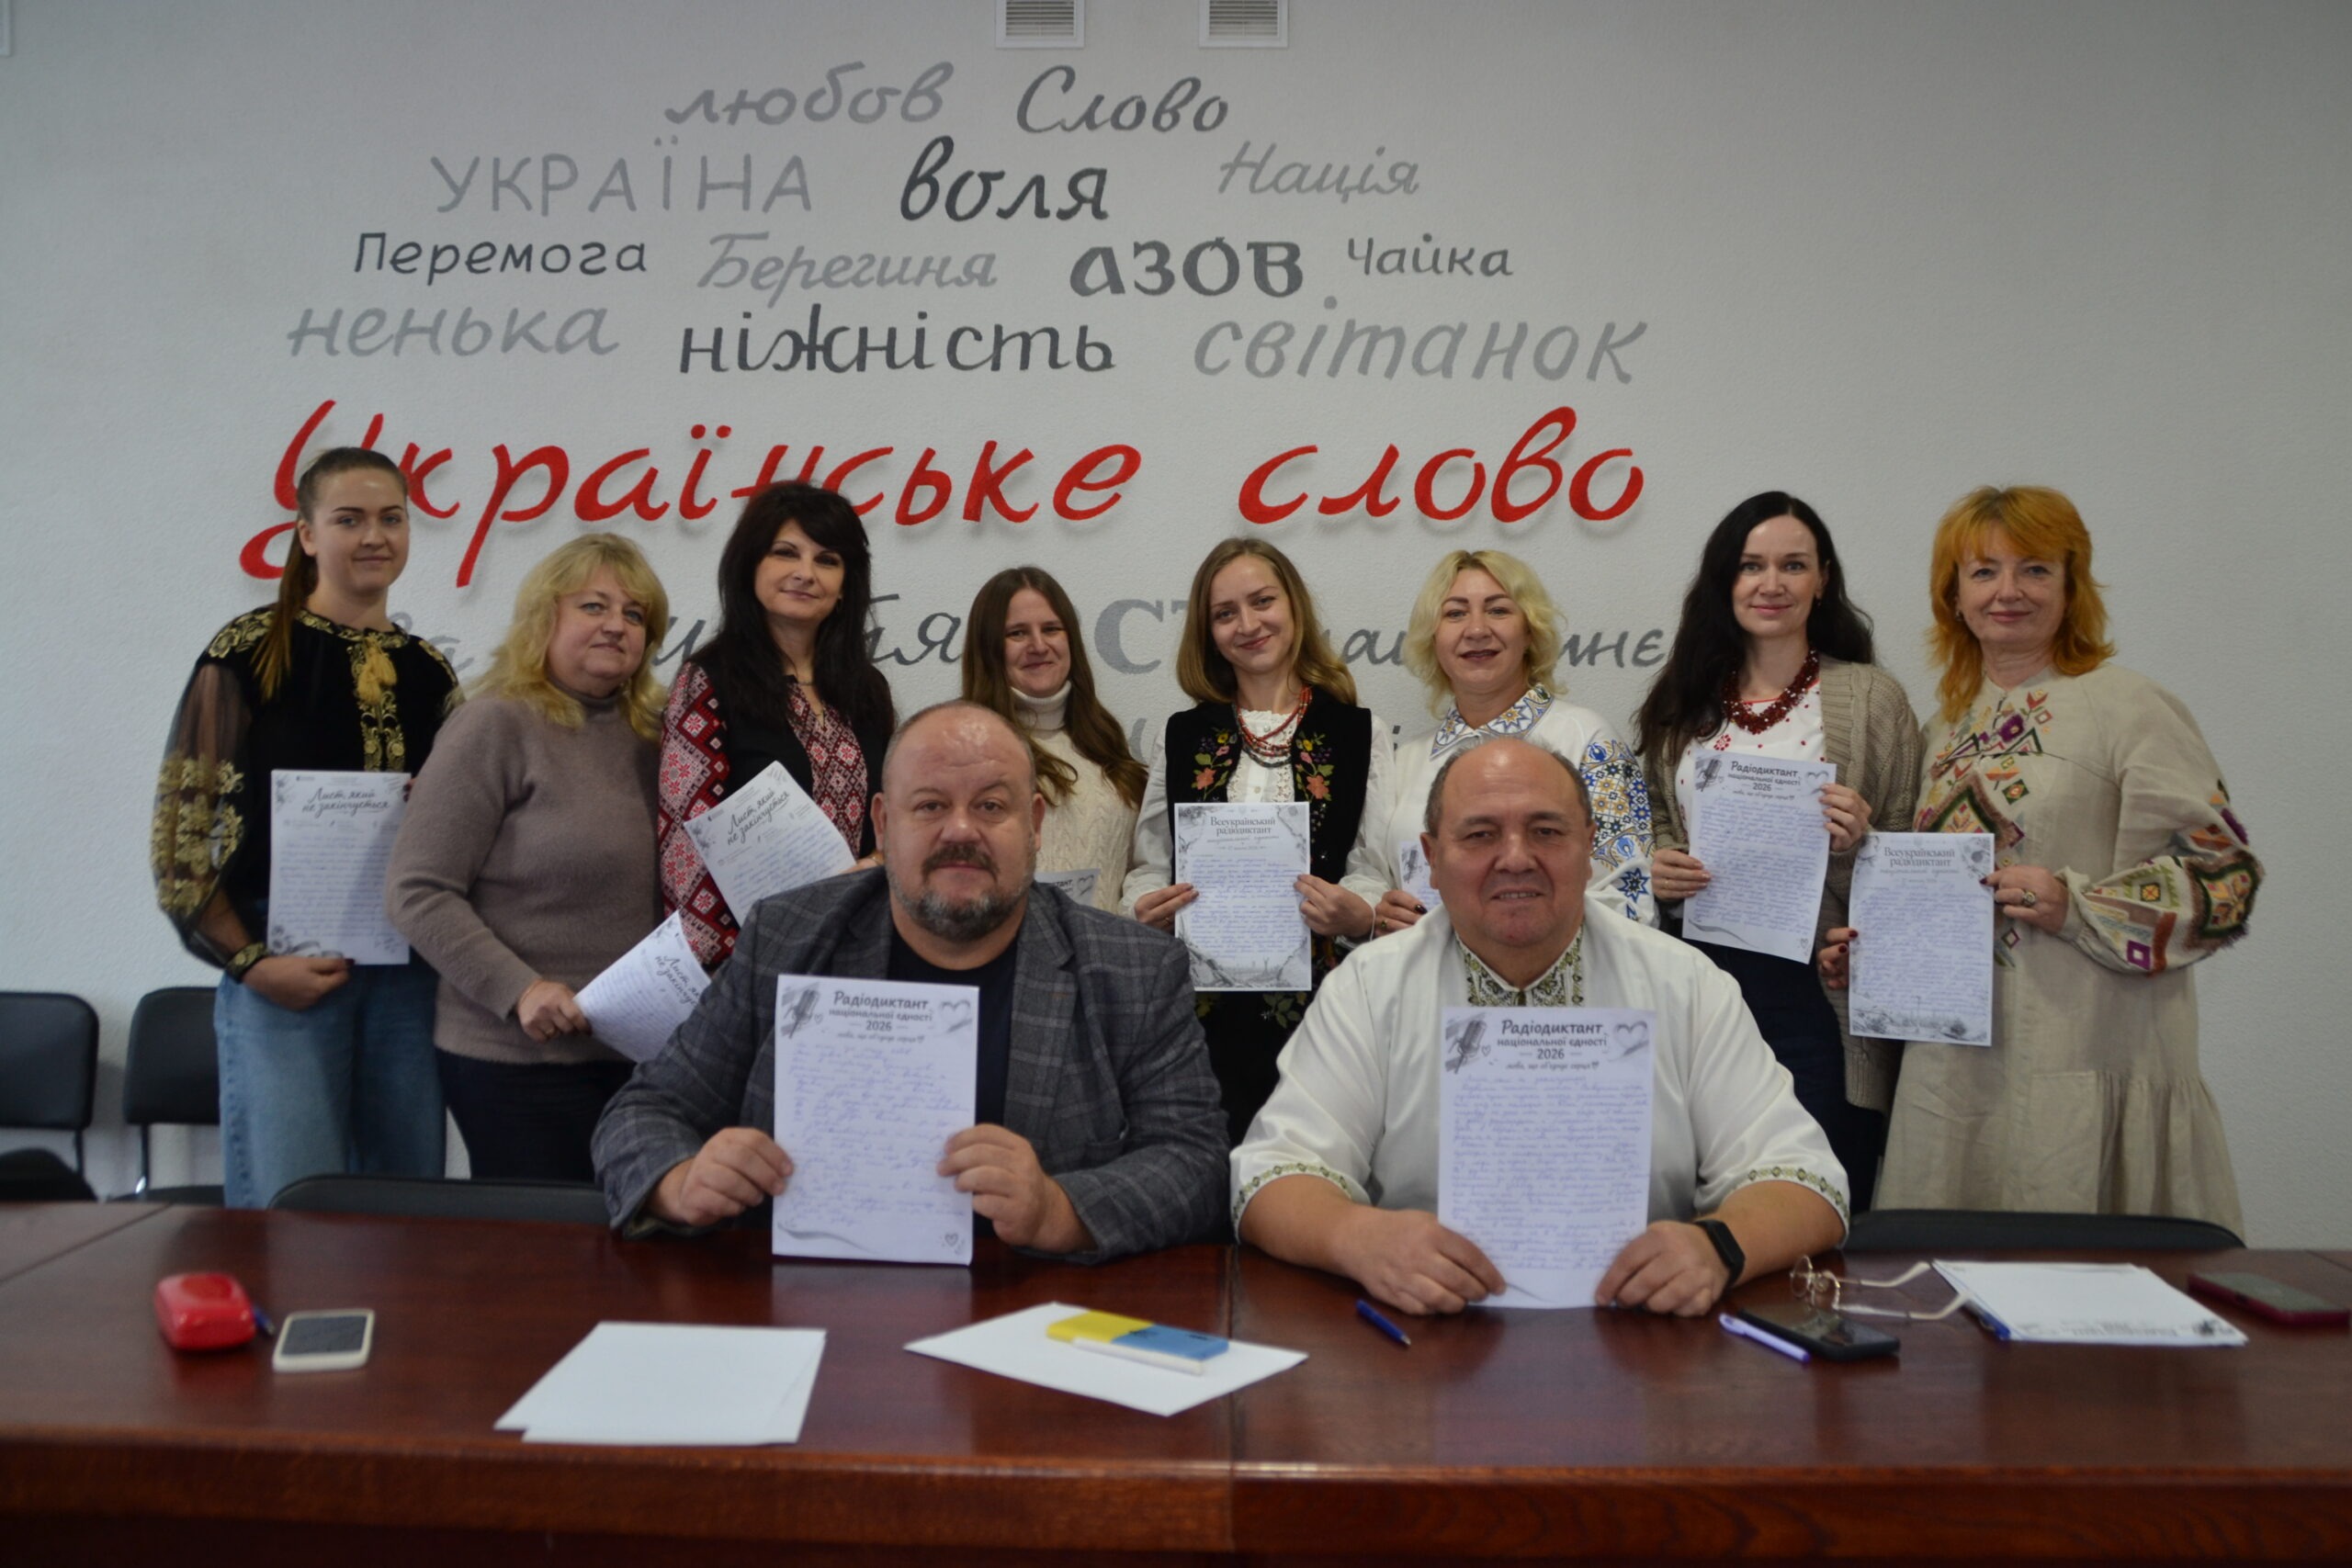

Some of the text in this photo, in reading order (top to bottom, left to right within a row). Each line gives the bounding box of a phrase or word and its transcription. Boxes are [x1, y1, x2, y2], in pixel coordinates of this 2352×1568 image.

[664, 62, 1228, 134] любов Слово
[430, 135, 1419, 223] УКРАЇНА воля Нація
[354, 231, 647, 287] Перемога
[697, 231, 997, 308] Берегиня
[1348, 233, 1513, 276] Чайка
[288, 296, 1648, 384] ненька ніжність світанок
[1238, 407, 1645, 524] слово
[1731, 761, 1799, 777] Радіодиктант
[1752, 783, 1772, 792] 2026
[1211, 817, 1275, 827] Всеукраїнський
[833, 990, 929, 1010] Радіодиктант
[829, 1009, 933, 1022] національної єдності
[865, 1021, 892, 1032] 2026
[1502, 1019, 1603, 1035] Радіодиктант
[1497, 1036, 1608, 1048] національної єдності
[1537, 1048, 1565, 1059] 2026
